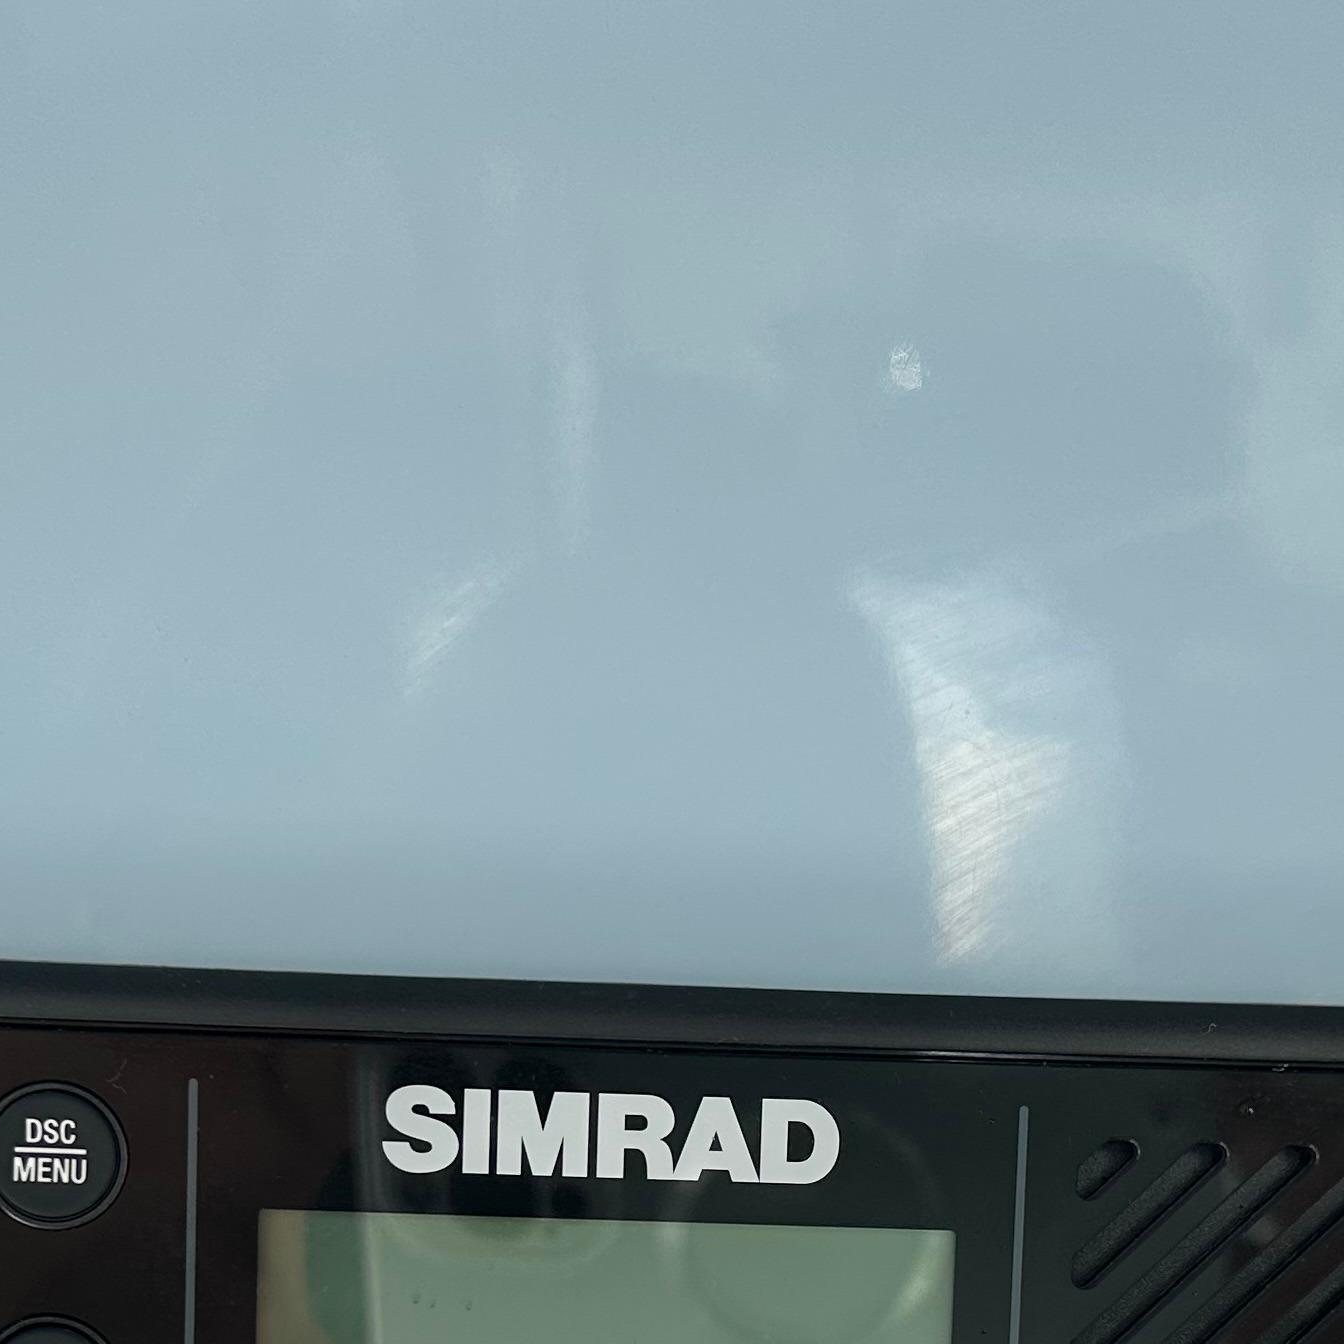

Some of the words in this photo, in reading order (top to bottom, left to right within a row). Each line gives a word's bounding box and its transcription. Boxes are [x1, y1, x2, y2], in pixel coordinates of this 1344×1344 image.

[24, 1118, 77, 1146] DSC
[382, 1085, 840, 1185] SIMRAD
[12, 1156, 88, 1185] MENU
